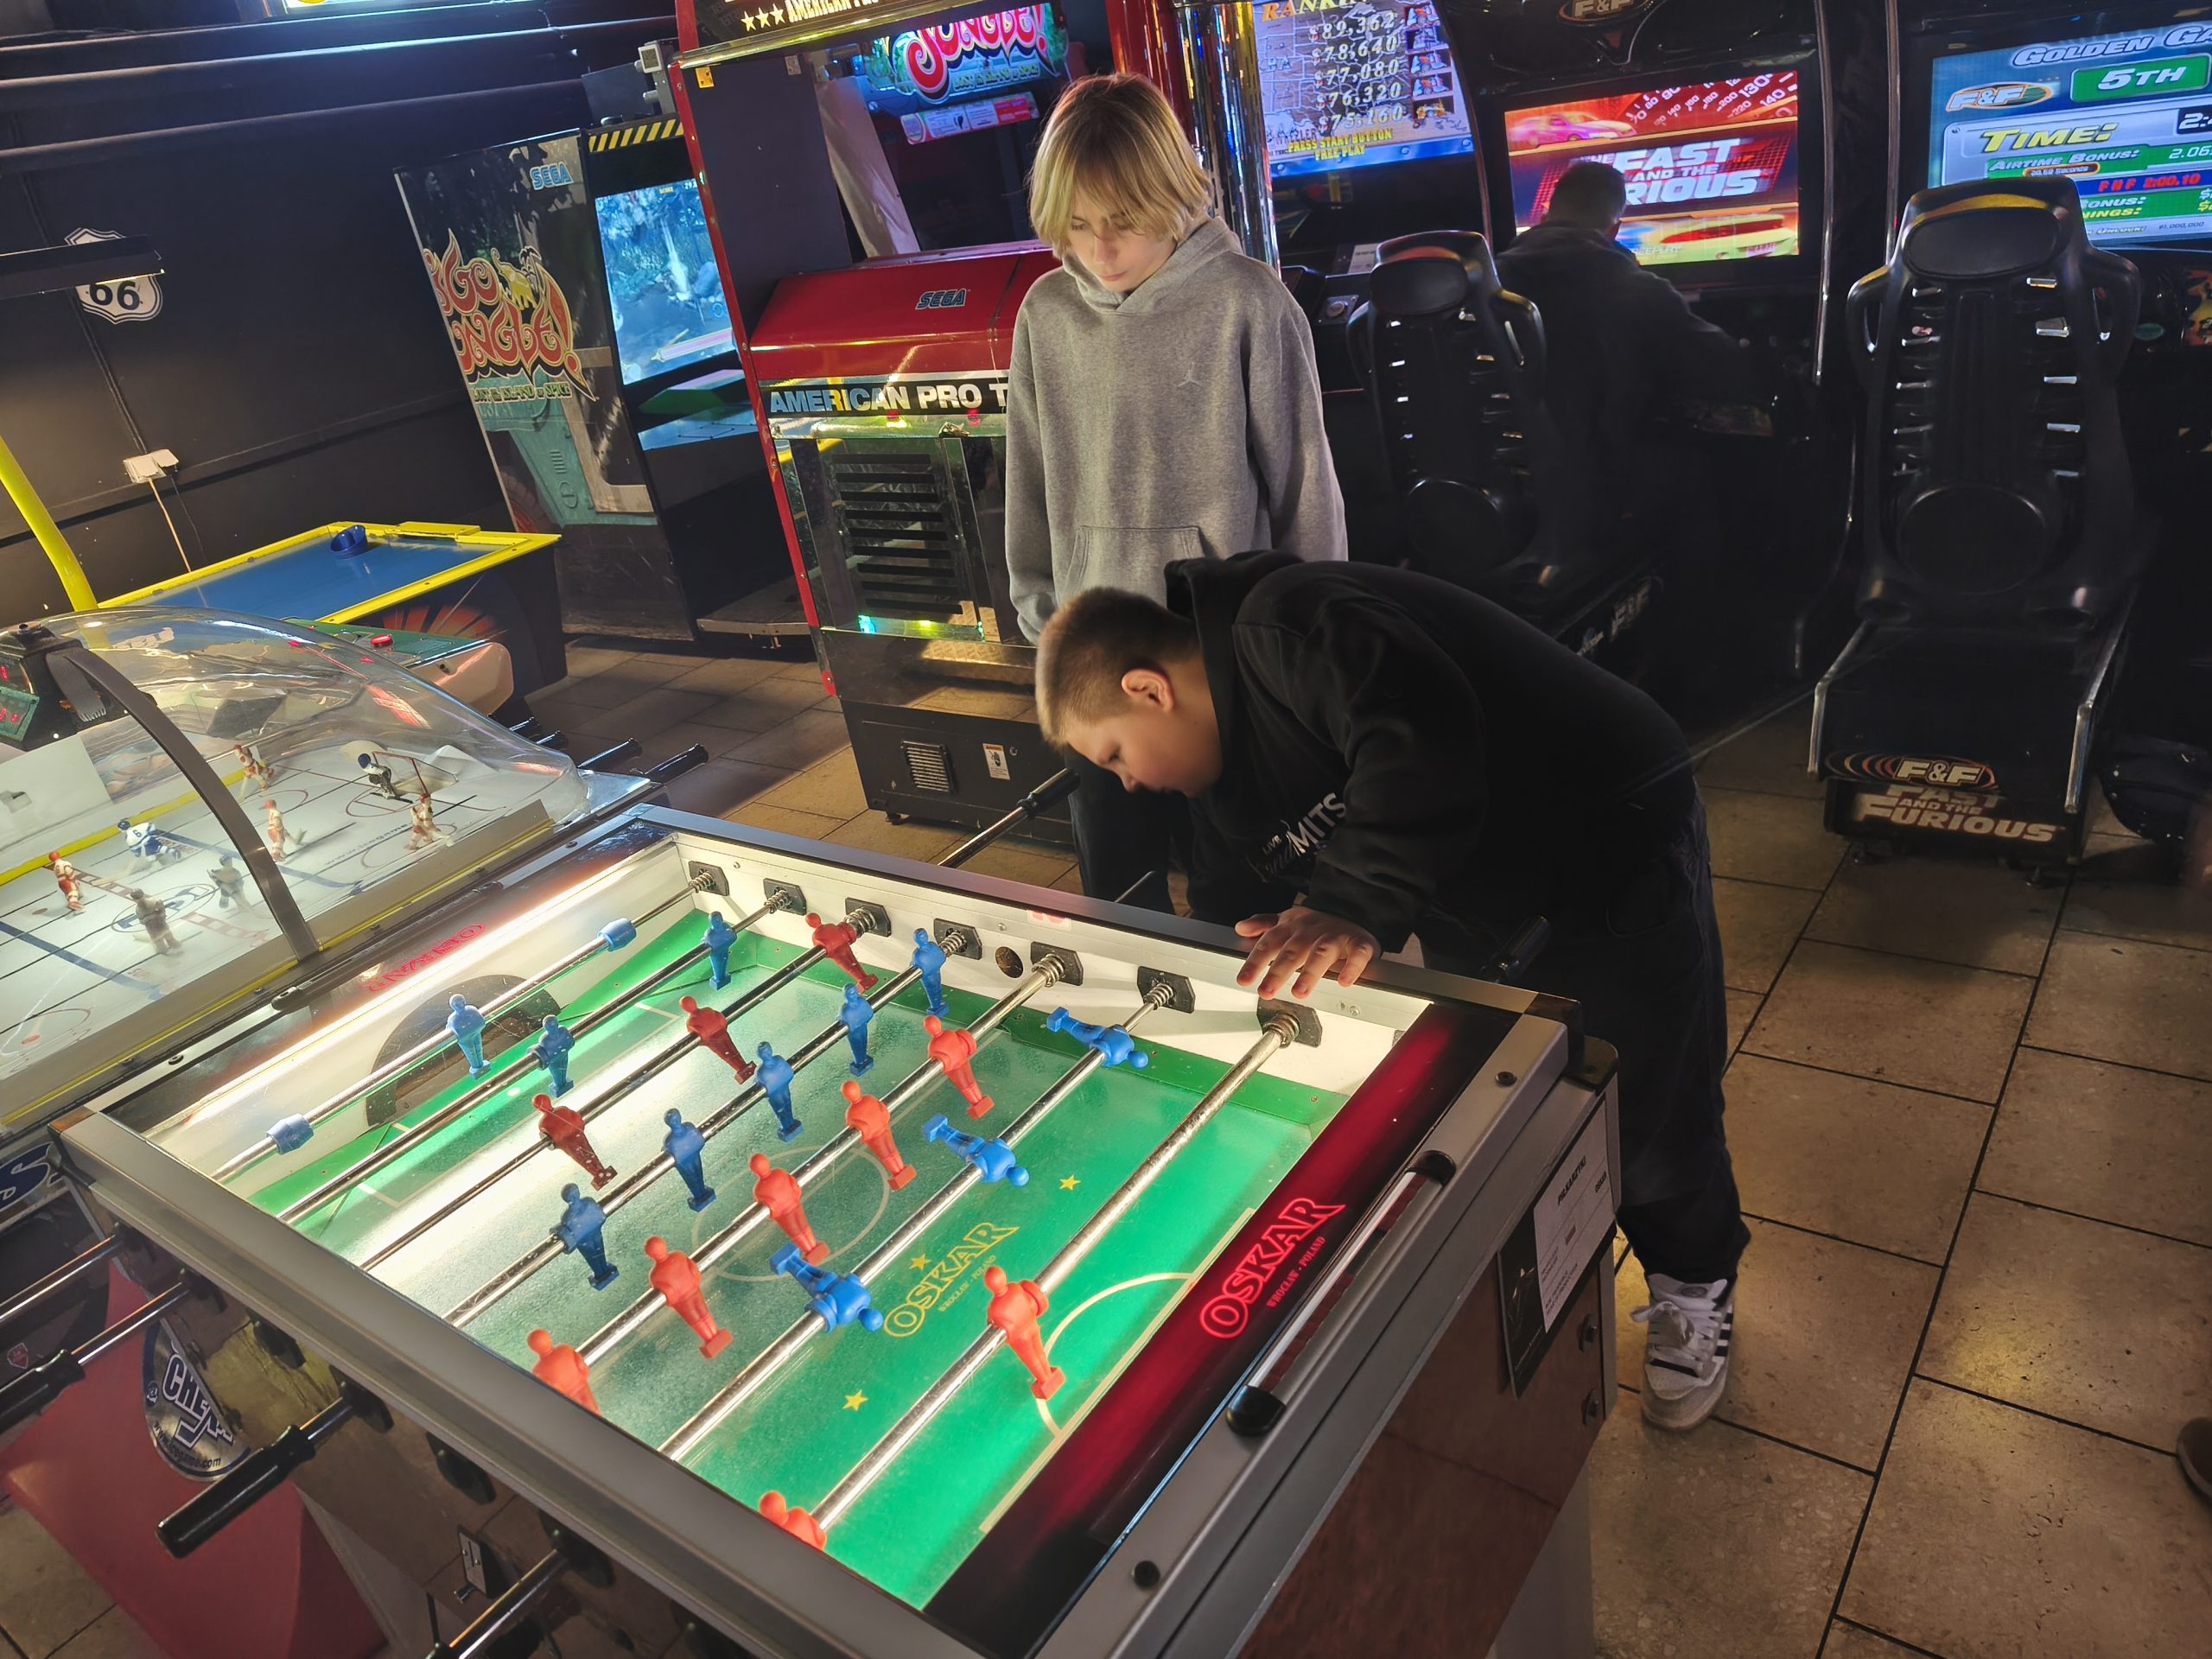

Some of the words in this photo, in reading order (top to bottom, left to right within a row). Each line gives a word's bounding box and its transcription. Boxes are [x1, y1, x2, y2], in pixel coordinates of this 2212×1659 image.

[1312, 36, 1399, 66] $78,640
[2012, 35, 2154, 67] GOLDEN
[1314, 59, 1400, 88] $77,080
[2098, 67, 2187, 91] 5TH
[1316, 82, 1402, 111] $76,320
[1947, 85, 2025, 111] F&F
[1287, 141, 1318, 153] PRESS
[1320, 135, 1350, 148] START
[1352, 129, 1393, 143] BUTTON
[1980, 122, 2118, 154] TIME:
[1315, 147, 1340, 161] FREE
[1342, 145, 1366, 156] PLAY
[1612, 138, 1741, 171] FAST
[1989, 156, 2063, 172] AIRTIME
[530, 162, 573, 190] SEGA
[1632, 168, 1675, 182] AND
[1681, 163, 1718, 176] THE
[1624, 169, 1760, 207] RIOUS
[89, 280, 140, 311] 66
[915, 289, 967, 309] SEGA
[770, 385, 911, 413] AMERICAN
[916, 384, 982, 410] PRO
[1897, 760, 1983, 784] F&F
[1886, 784, 2006, 809] FAST
[1898, 798, 1940, 810] AND
[1945, 802, 1983, 815] THE
[1858, 793, 2060, 842] FURIOUS
[884, 1222, 1020, 1338] OSKAR
[1200, 1198, 1346, 1339] OSKAR
